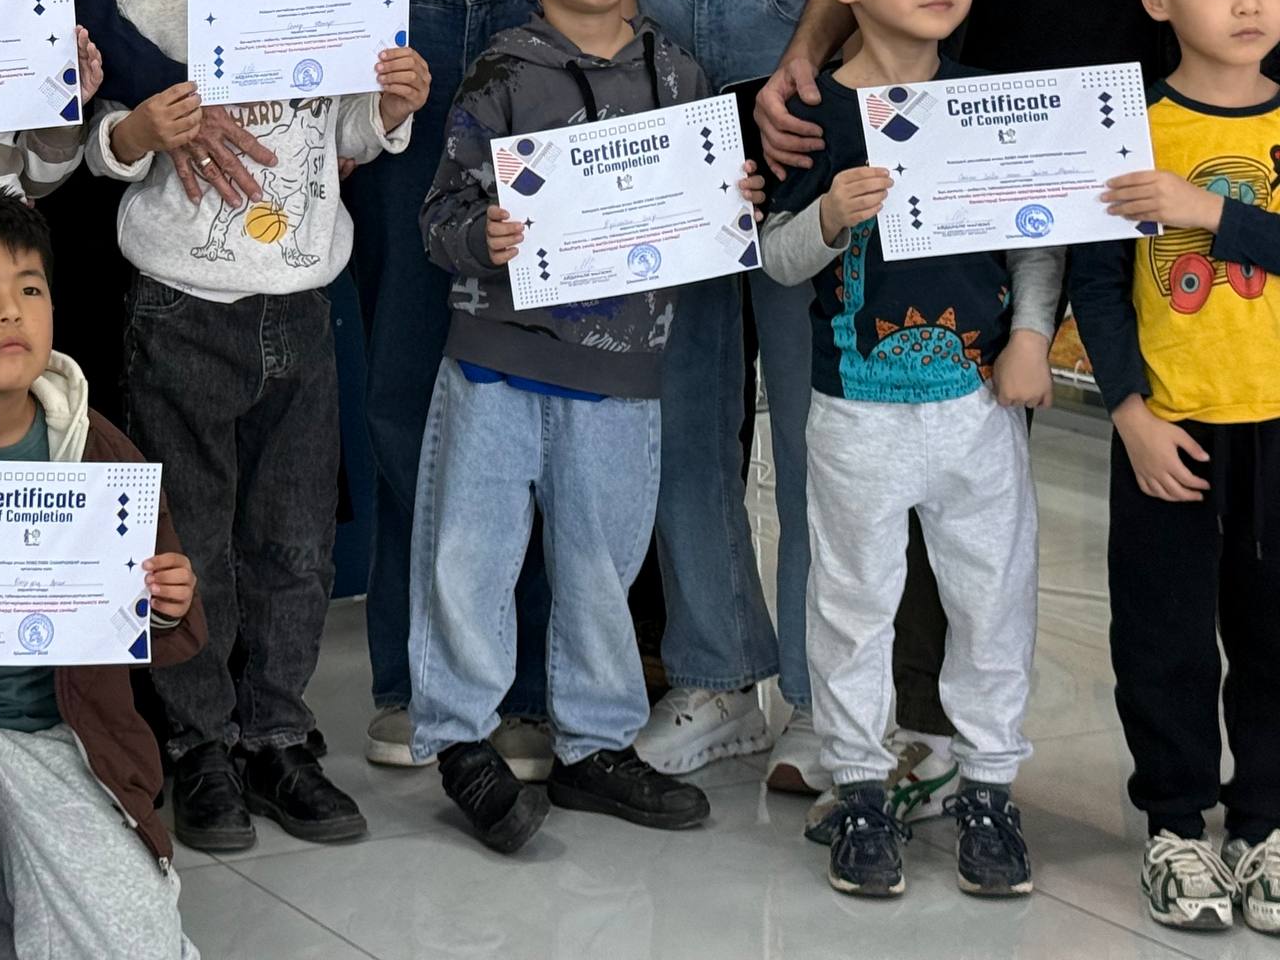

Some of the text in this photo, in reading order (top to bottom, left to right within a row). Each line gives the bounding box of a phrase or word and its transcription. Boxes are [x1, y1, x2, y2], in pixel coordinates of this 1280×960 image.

[947, 92, 1061, 117] Certificate
[960, 110, 1049, 128] of Completion
[570, 134, 670, 167] Certificate
[583, 153, 660, 177] of Completion
[5, 509, 73, 525] Completion
